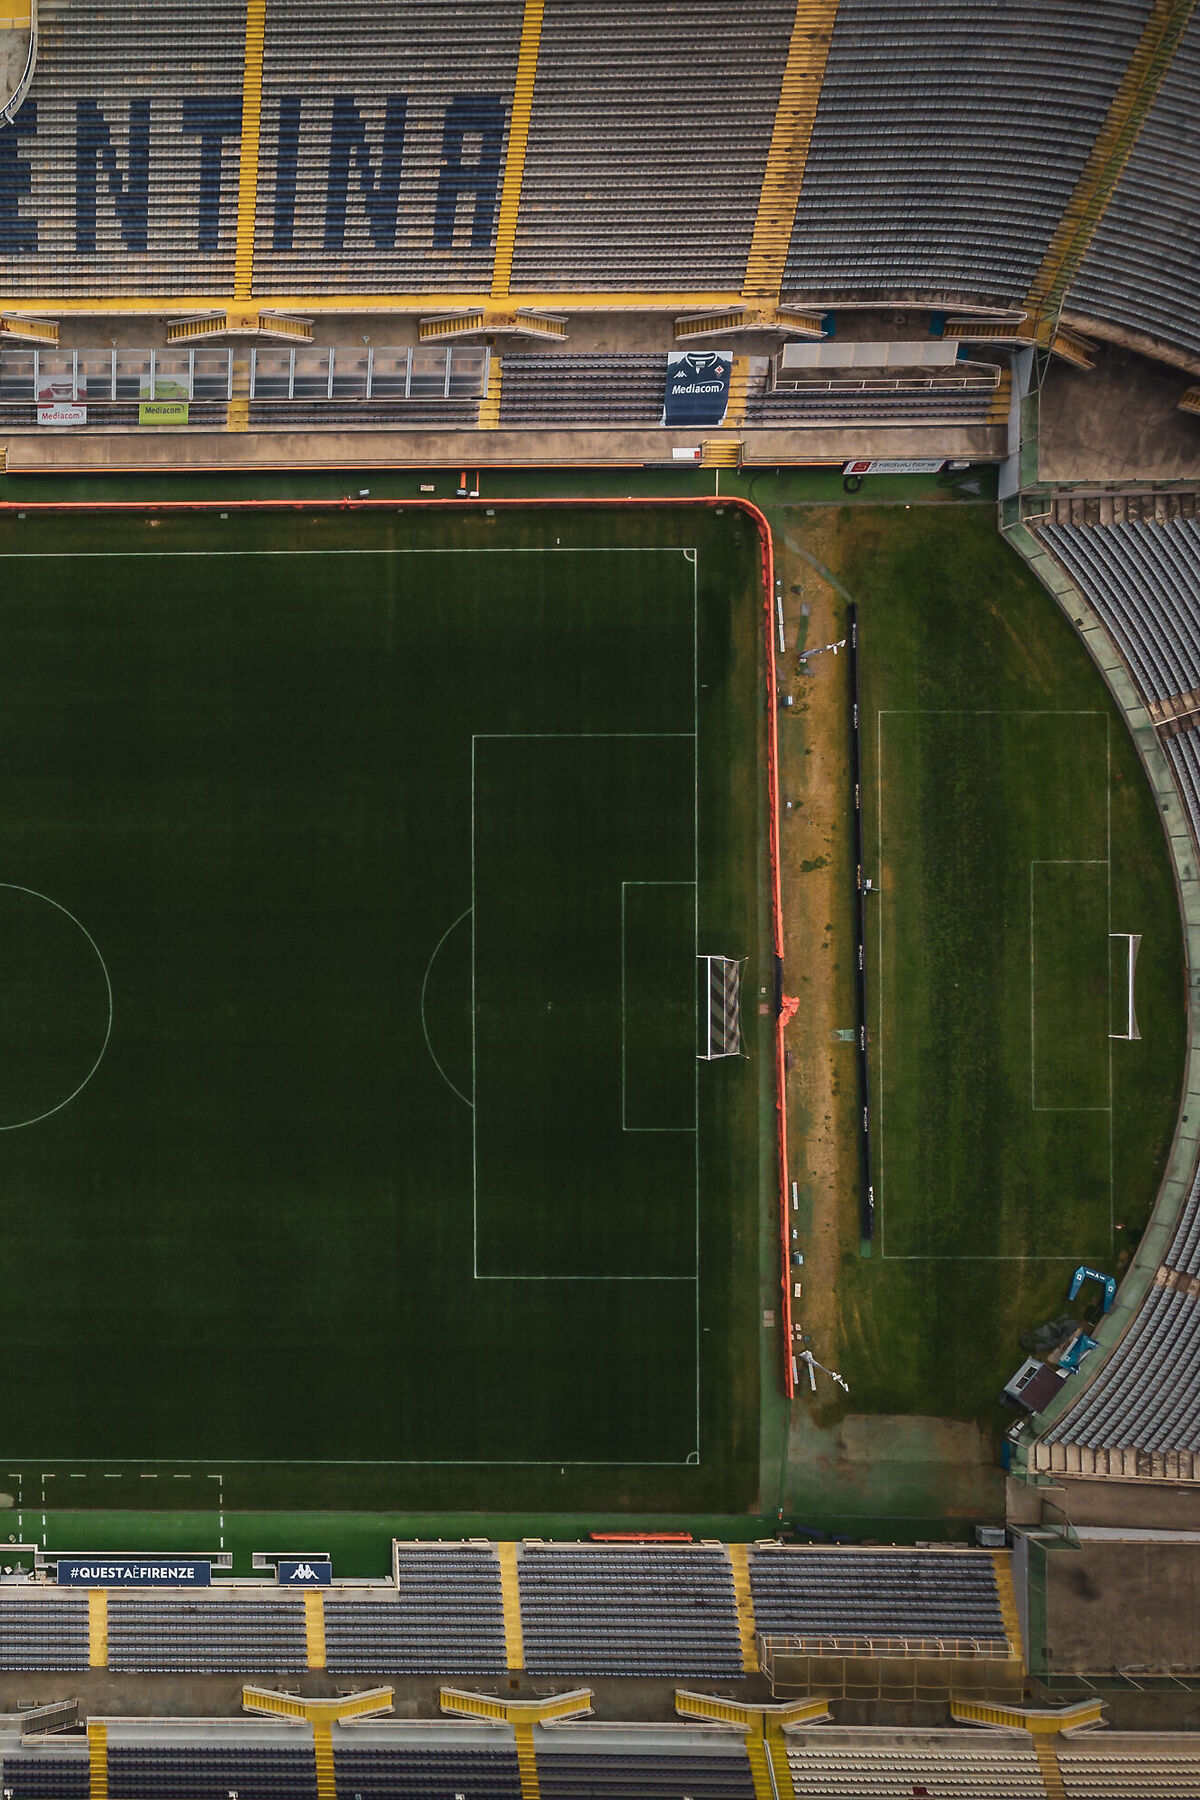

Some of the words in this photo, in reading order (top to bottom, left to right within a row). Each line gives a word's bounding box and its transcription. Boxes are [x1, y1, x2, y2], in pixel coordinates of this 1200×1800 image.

[672, 383, 720, 394] Mediacom
[145, 405, 181, 414] Mediacom
[41, 411, 80, 420] Mediacom
[70, 1565, 195, 1579] #QUESTAÈFIRENZE
